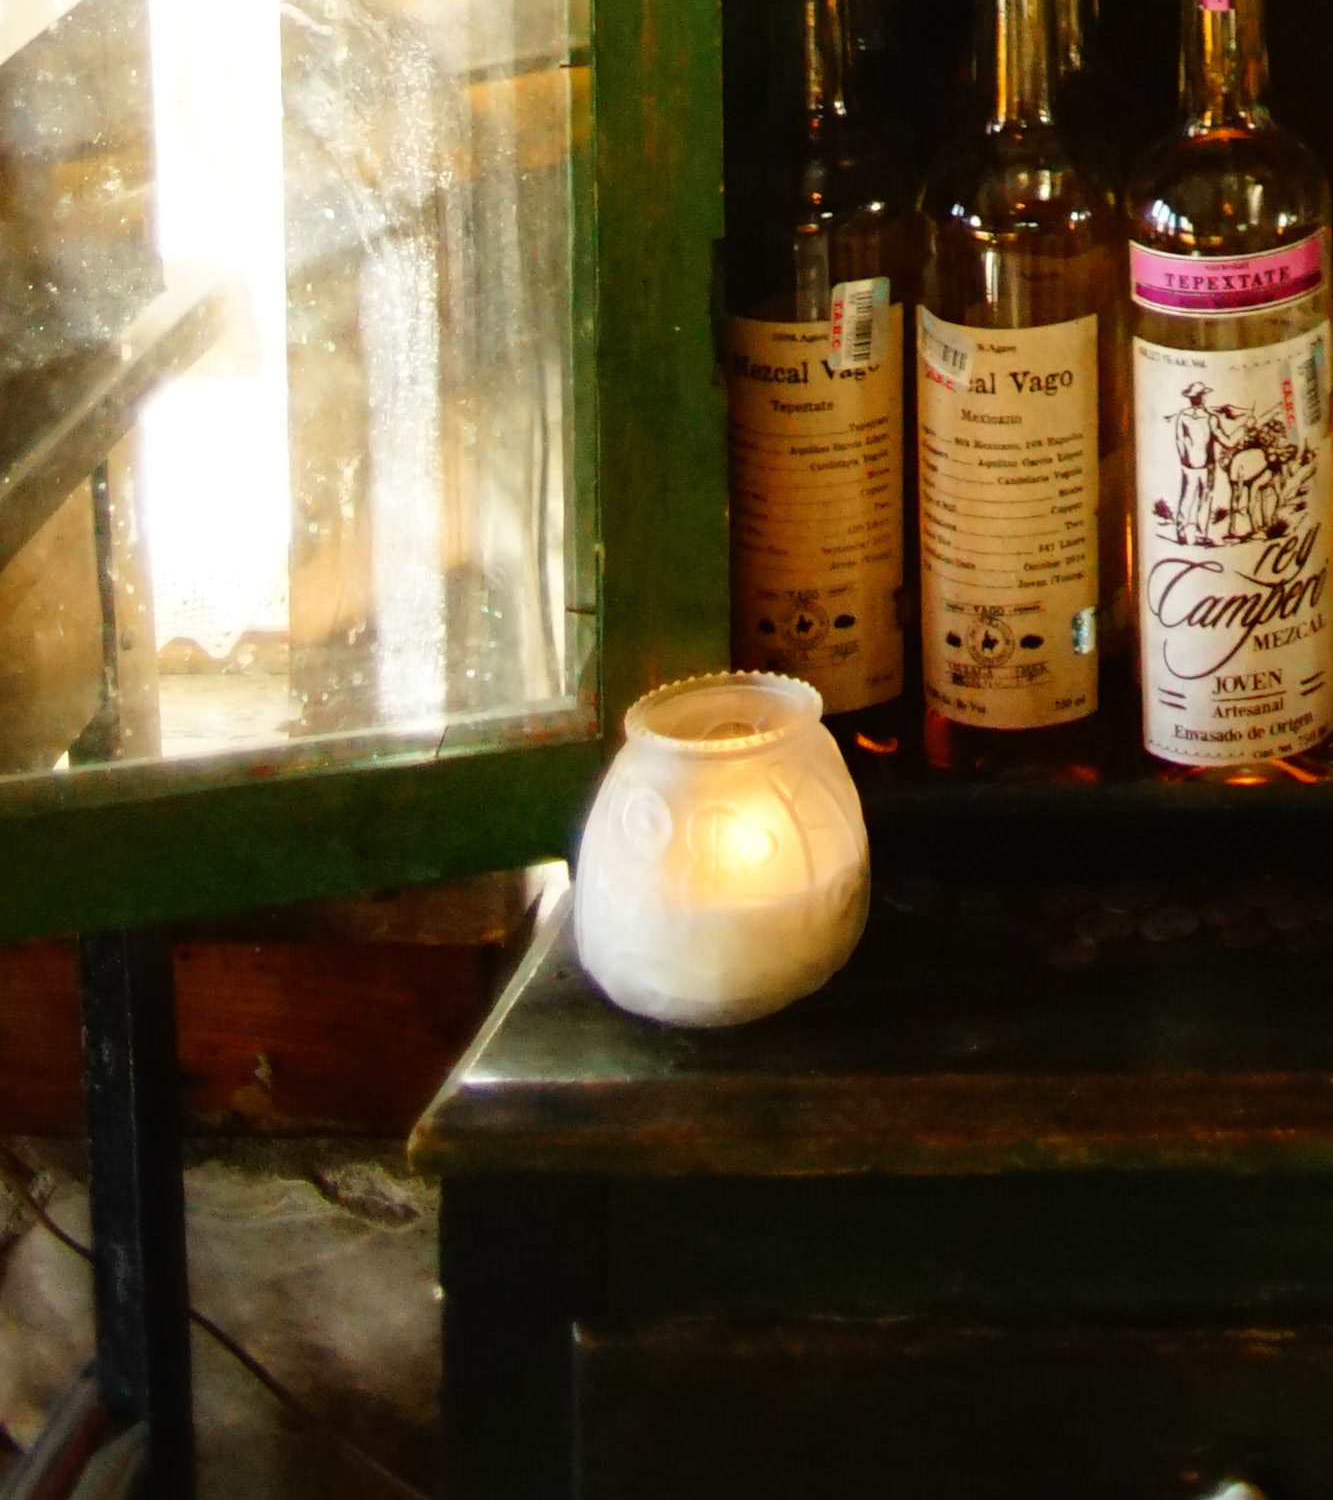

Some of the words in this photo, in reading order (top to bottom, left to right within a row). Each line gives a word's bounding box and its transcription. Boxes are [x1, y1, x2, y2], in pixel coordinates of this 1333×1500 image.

[1163, 264, 1291, 292] TEPEXTATE
[1009, 369, 1074, 396] Vago
[961, 409, 1022, 425] Mexicano
[1253, 613, 1327, 652] MEZCAL
[1212, 667, 1284, 695] JOVEN
[1212, 697, 1284, 719] Artesanal
[1174, 723, 1242, 742] Envasado
[1247, 726, 1264, 740] de
[1270, 712, 1314, 736] Origen
